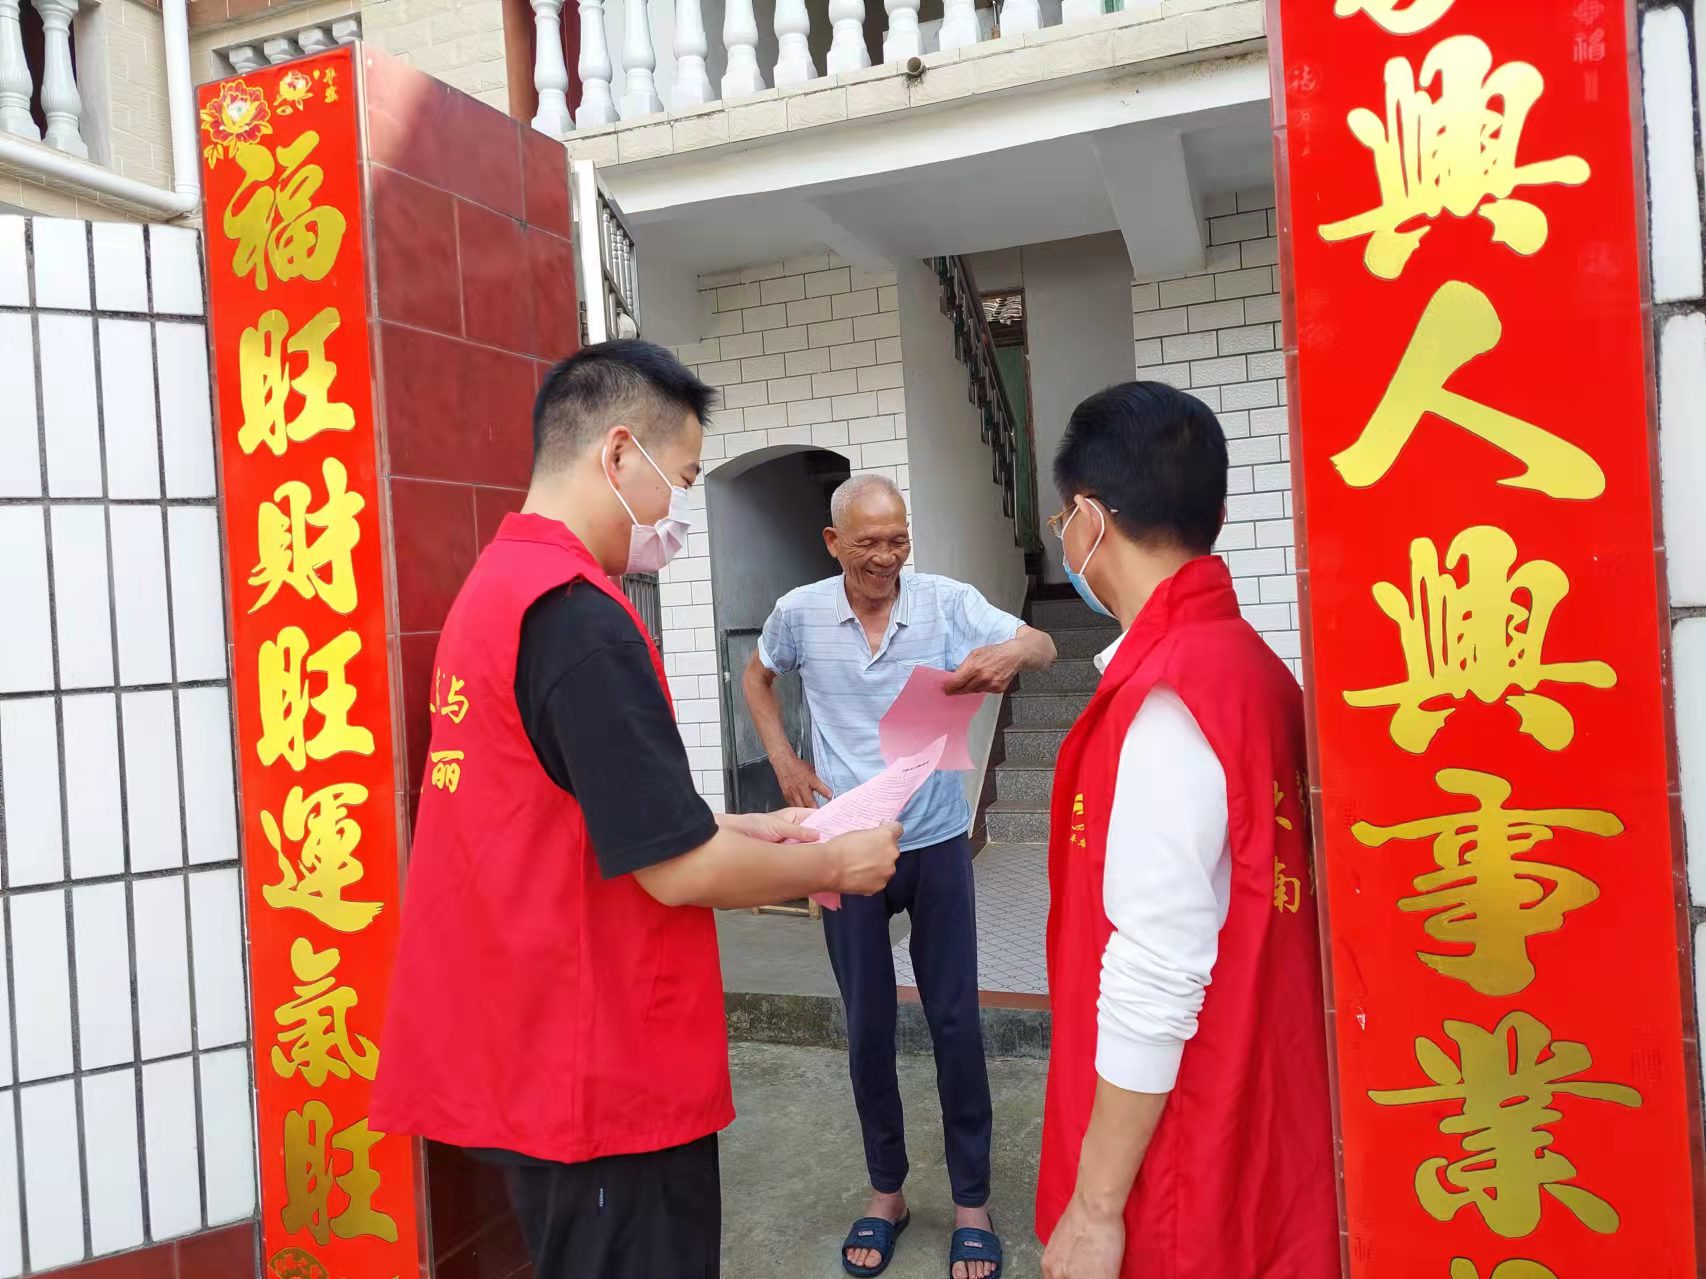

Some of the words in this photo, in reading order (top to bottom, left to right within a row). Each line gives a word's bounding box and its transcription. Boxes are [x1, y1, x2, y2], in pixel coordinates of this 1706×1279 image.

[223, 130, 399, 1244] 福旺財旺運氣旺
[1317, 0, 1642, 1279] 興人興事業
